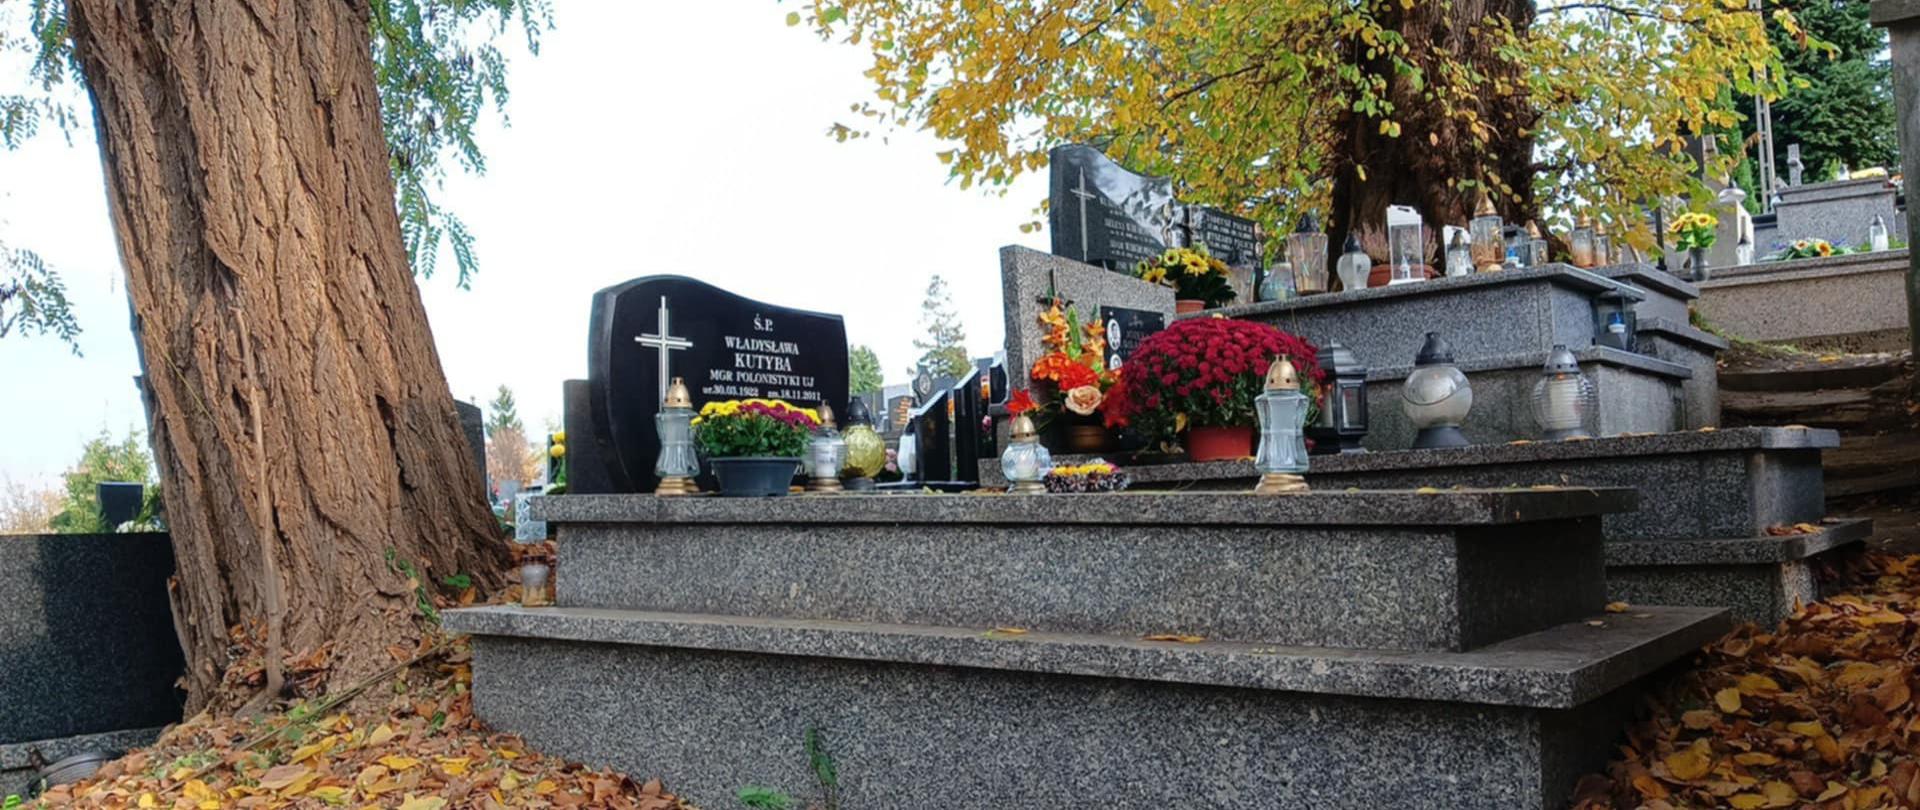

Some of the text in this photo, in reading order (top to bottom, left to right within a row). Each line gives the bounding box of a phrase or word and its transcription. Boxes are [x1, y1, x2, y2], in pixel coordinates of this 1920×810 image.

[724, 335, 799, 355] WŁADYSŁAWA
[735, 353, 792, 371] KUTYBA
[710, 369, 814, 387] MGR POLONISTYKI UJ
